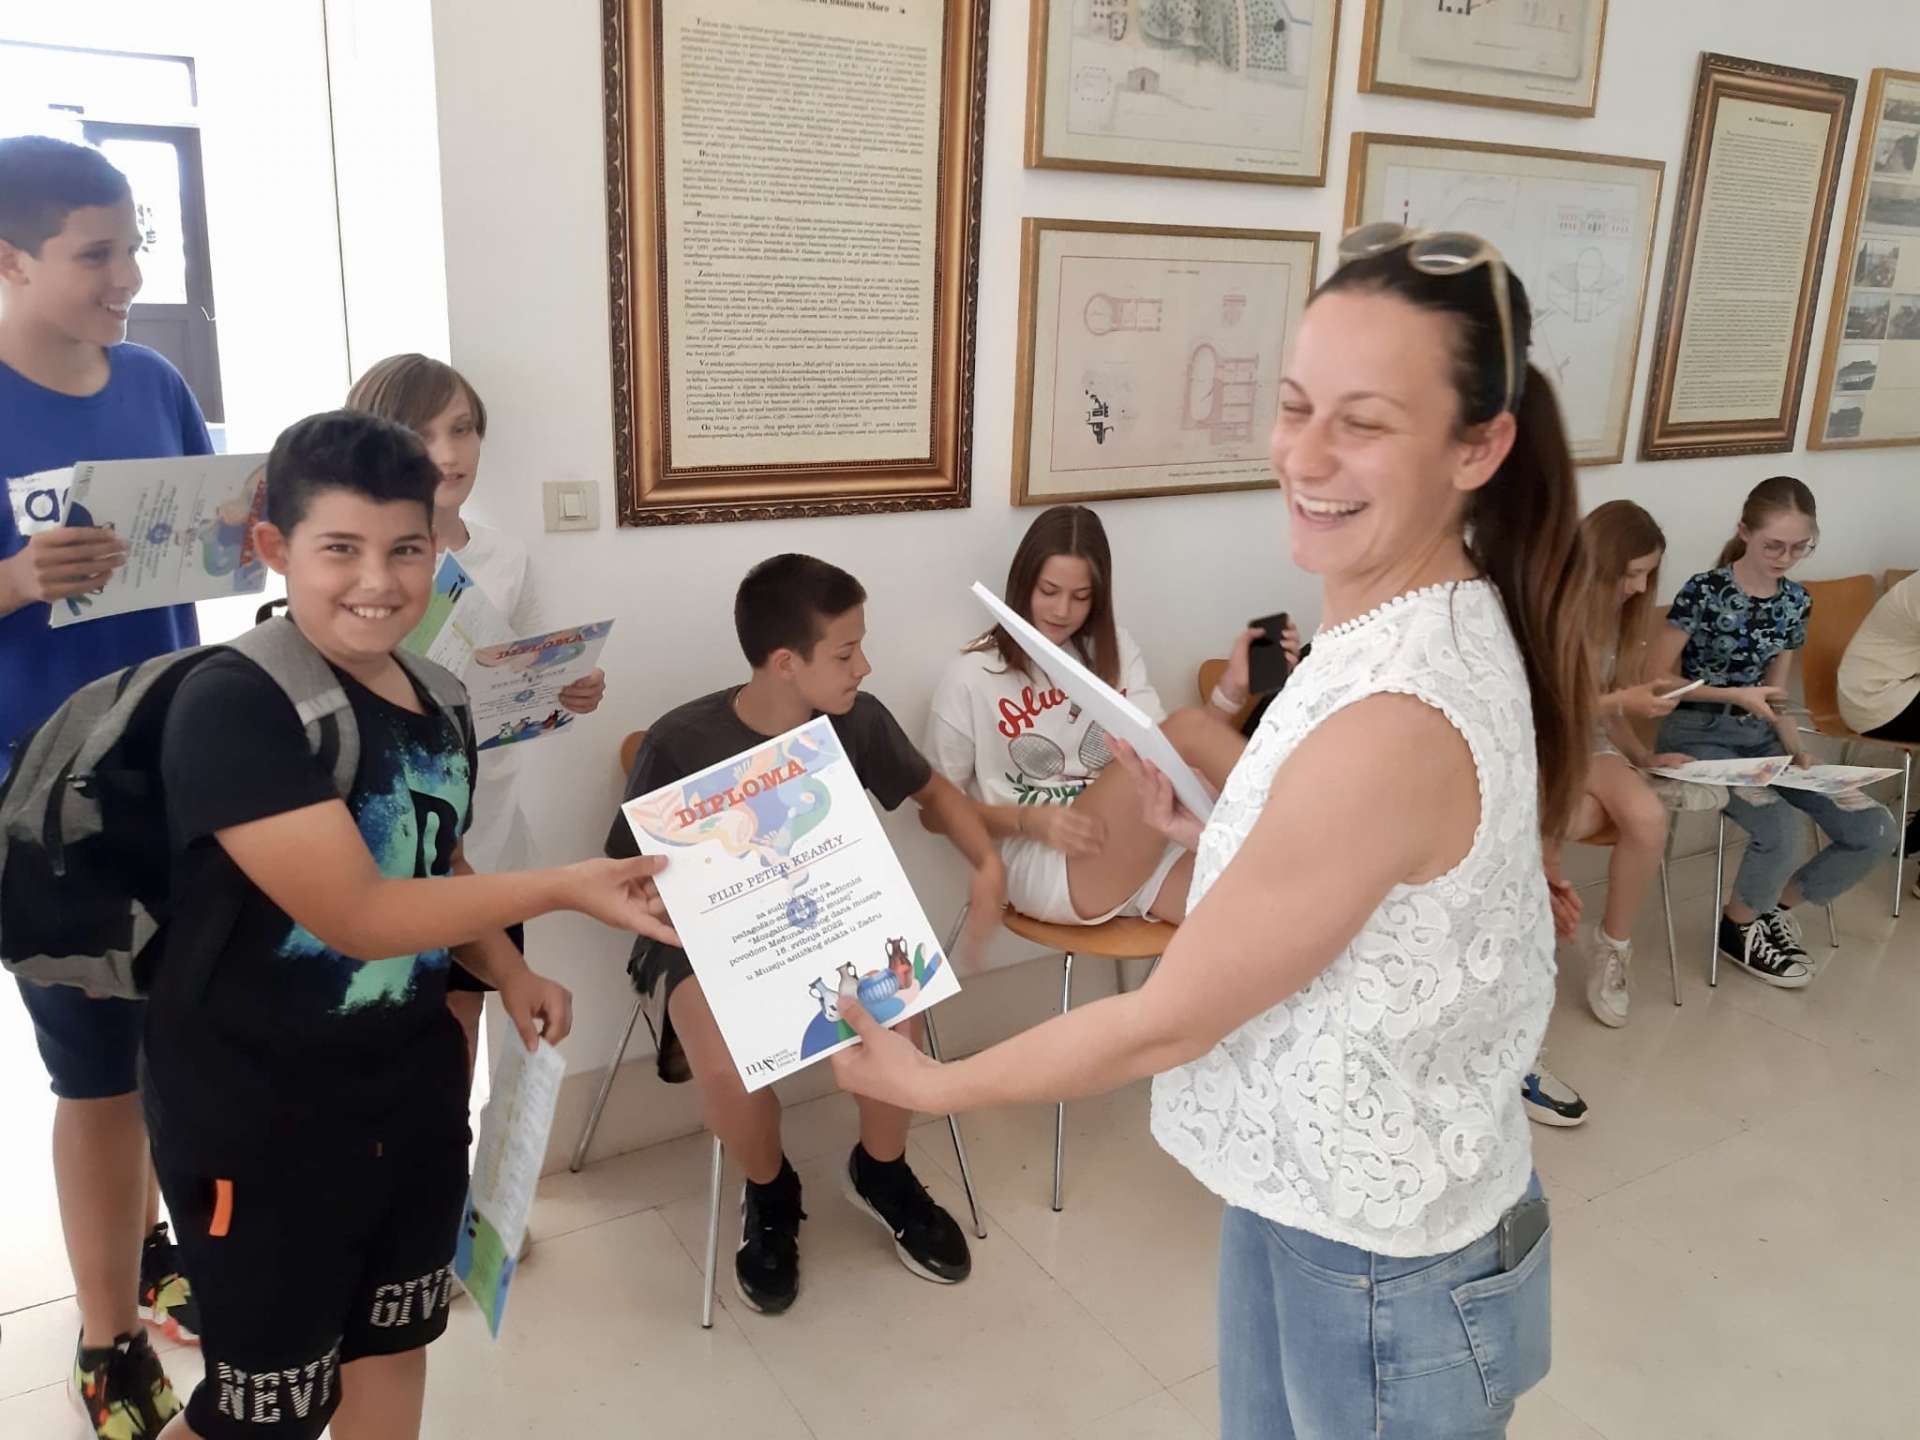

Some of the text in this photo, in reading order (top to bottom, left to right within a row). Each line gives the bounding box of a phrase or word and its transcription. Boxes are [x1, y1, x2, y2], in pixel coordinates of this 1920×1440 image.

[998, 686, 1069, 738] Alw
[674, 755, 808, 830] DIPLOMA
[708, 834, 846, 905] FILIP PETER KEANLY
[819, 881, 831, 890] na
[729, 944, 768, 967] povodom
[830, 904, 852, 918] dana
[852, 889, 882, 908] muzeja
[754, 958, 786, 978] Muzeju
[856, 912, 883, 928] Zadru
[790, 931, 821, 951] svibnja
